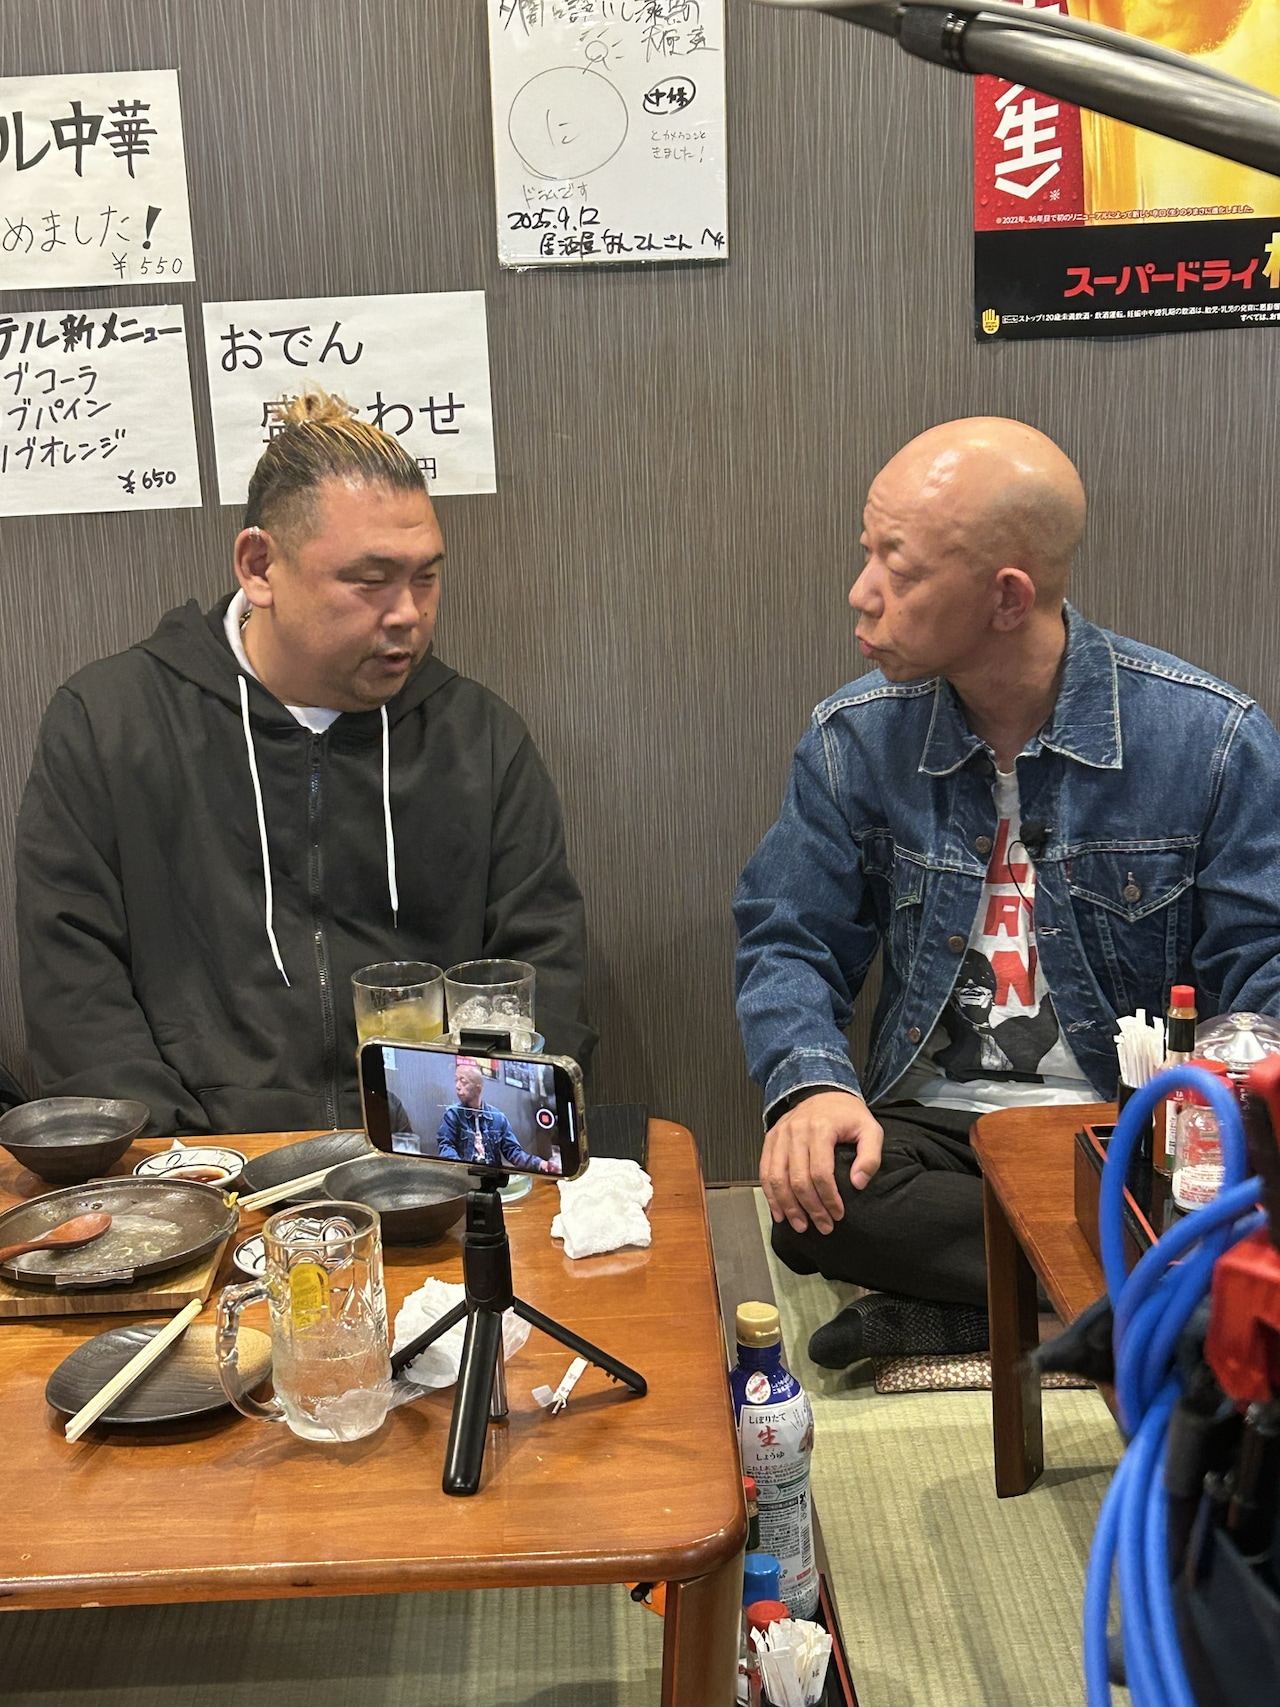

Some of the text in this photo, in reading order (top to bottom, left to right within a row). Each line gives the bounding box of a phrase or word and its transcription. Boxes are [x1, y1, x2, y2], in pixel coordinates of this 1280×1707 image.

[0, 99, 158, 179] ル中華
[508, 206, 601, 231] 2025.9.12
[220, 321, 363, 371] おでん
[117, 469, 177, 494] ¥650
[749, 1413, 787, 1424] しぼりたて
[757, 1425, 781, 1448] 生
